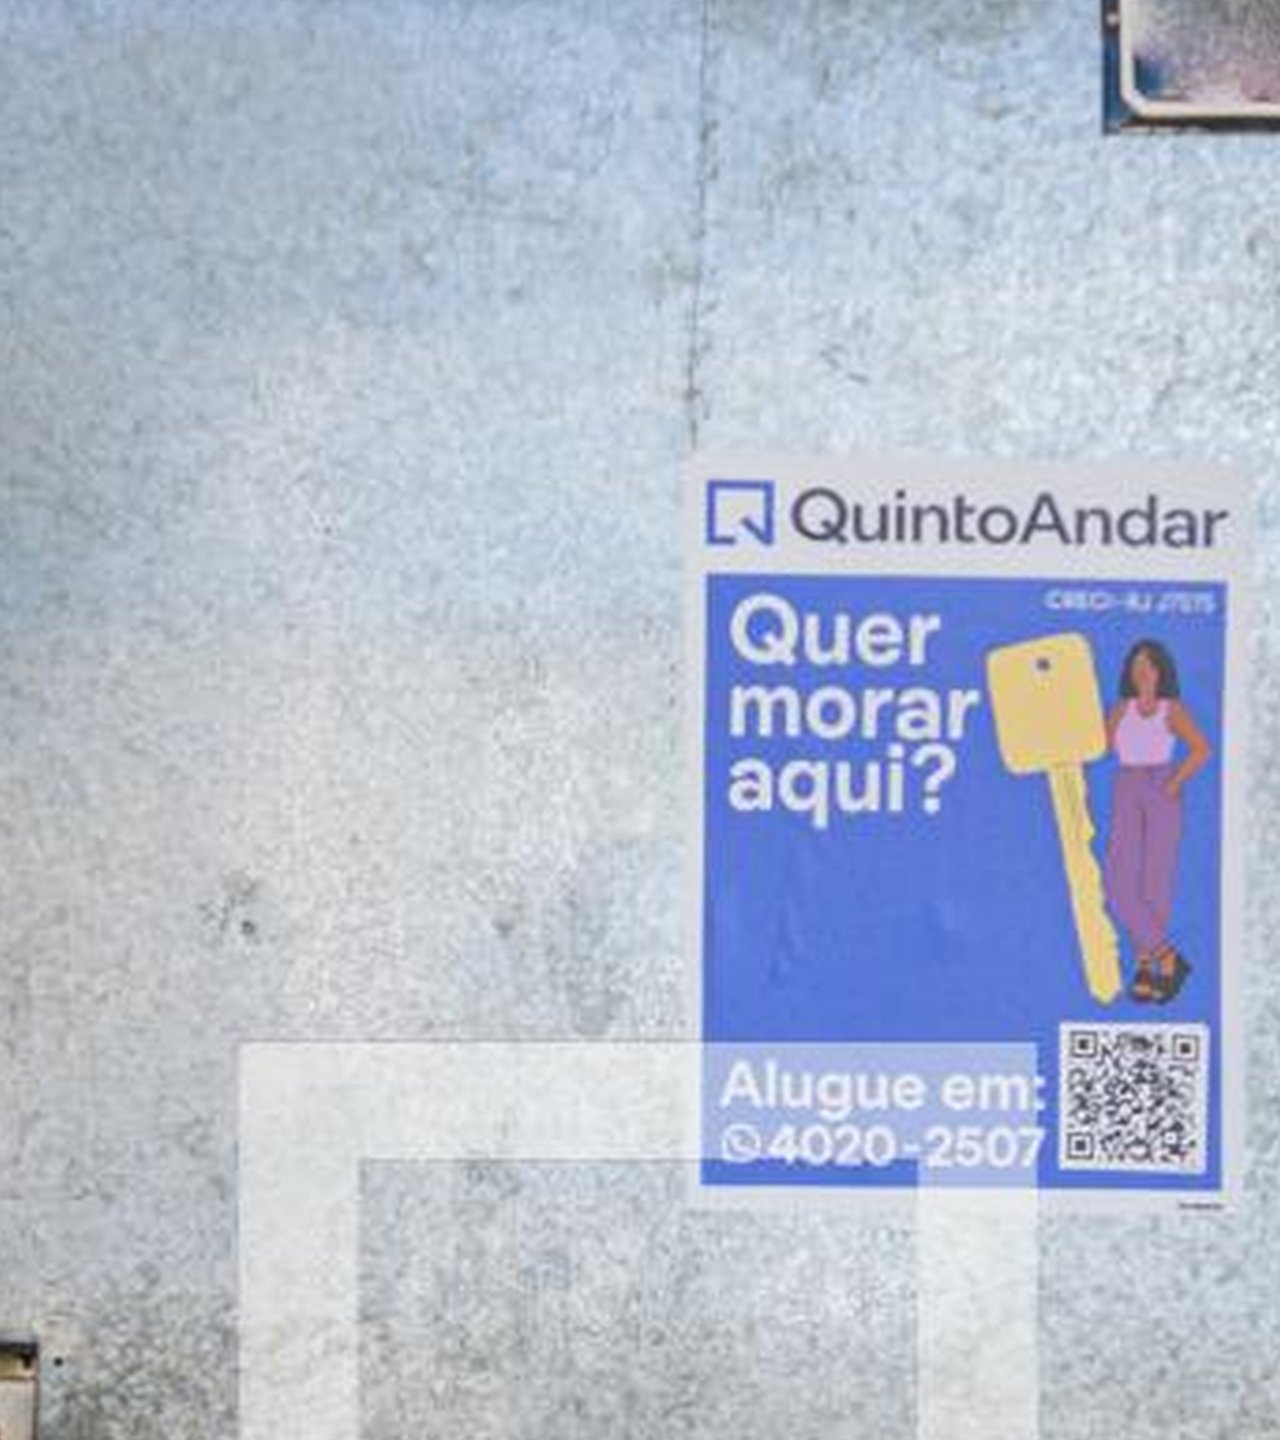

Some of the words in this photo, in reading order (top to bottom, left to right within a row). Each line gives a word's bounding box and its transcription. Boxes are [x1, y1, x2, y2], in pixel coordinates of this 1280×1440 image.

[791, 487, 1229, 547] QuintoAndar
[730, 592, 941, 666] Quer
[729, 685, 980, 740] morar
[728, 742, 957, 830] aqui?
[721, 1060, 926, 1120] Alugue
[941, 1073, 1046, 1111] em:
[769, 1123, 1047, 1168] 4020-2507
